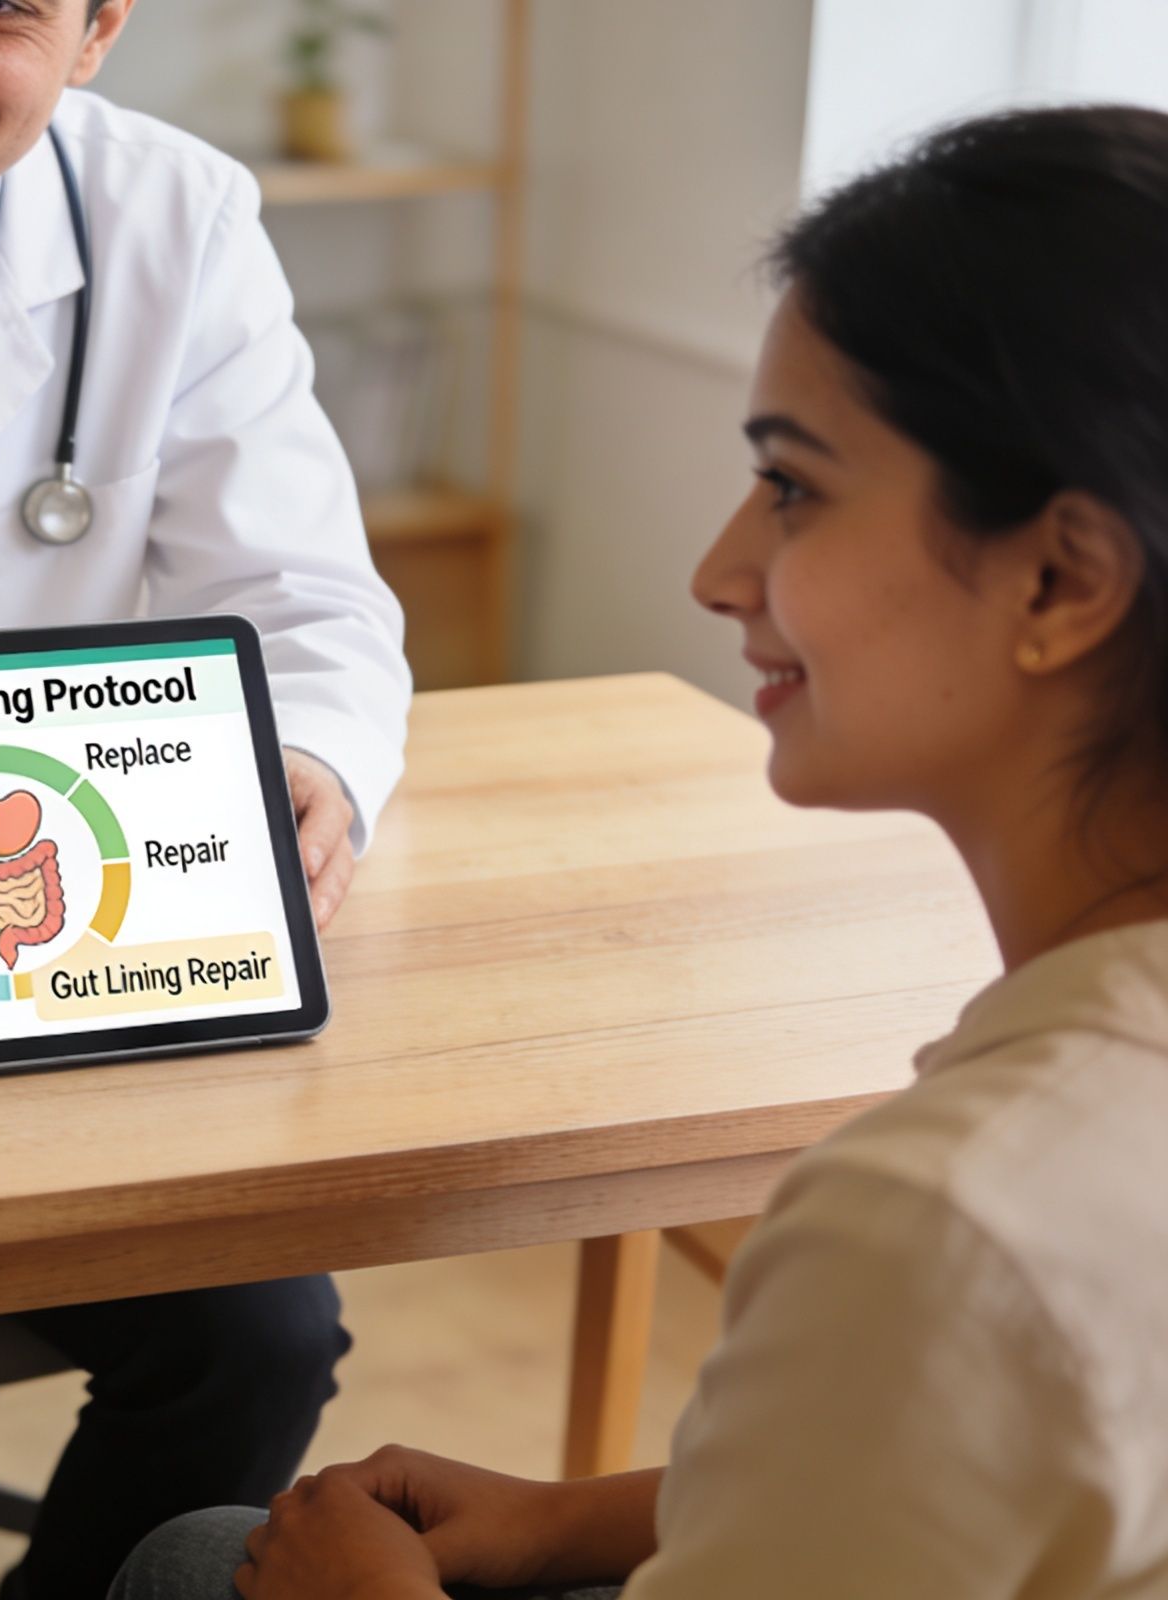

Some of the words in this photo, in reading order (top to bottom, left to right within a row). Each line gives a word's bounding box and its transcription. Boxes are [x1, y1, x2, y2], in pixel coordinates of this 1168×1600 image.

[43, 666, 197, 713] Protocol
[85, 737, 191, 773] Replace
[144, 834, 229, 871] Repair
[51, 969, 100, 1000] Gut
[105, 962, 182, 996] Lining
[187, 951, 271, 991] Repair
